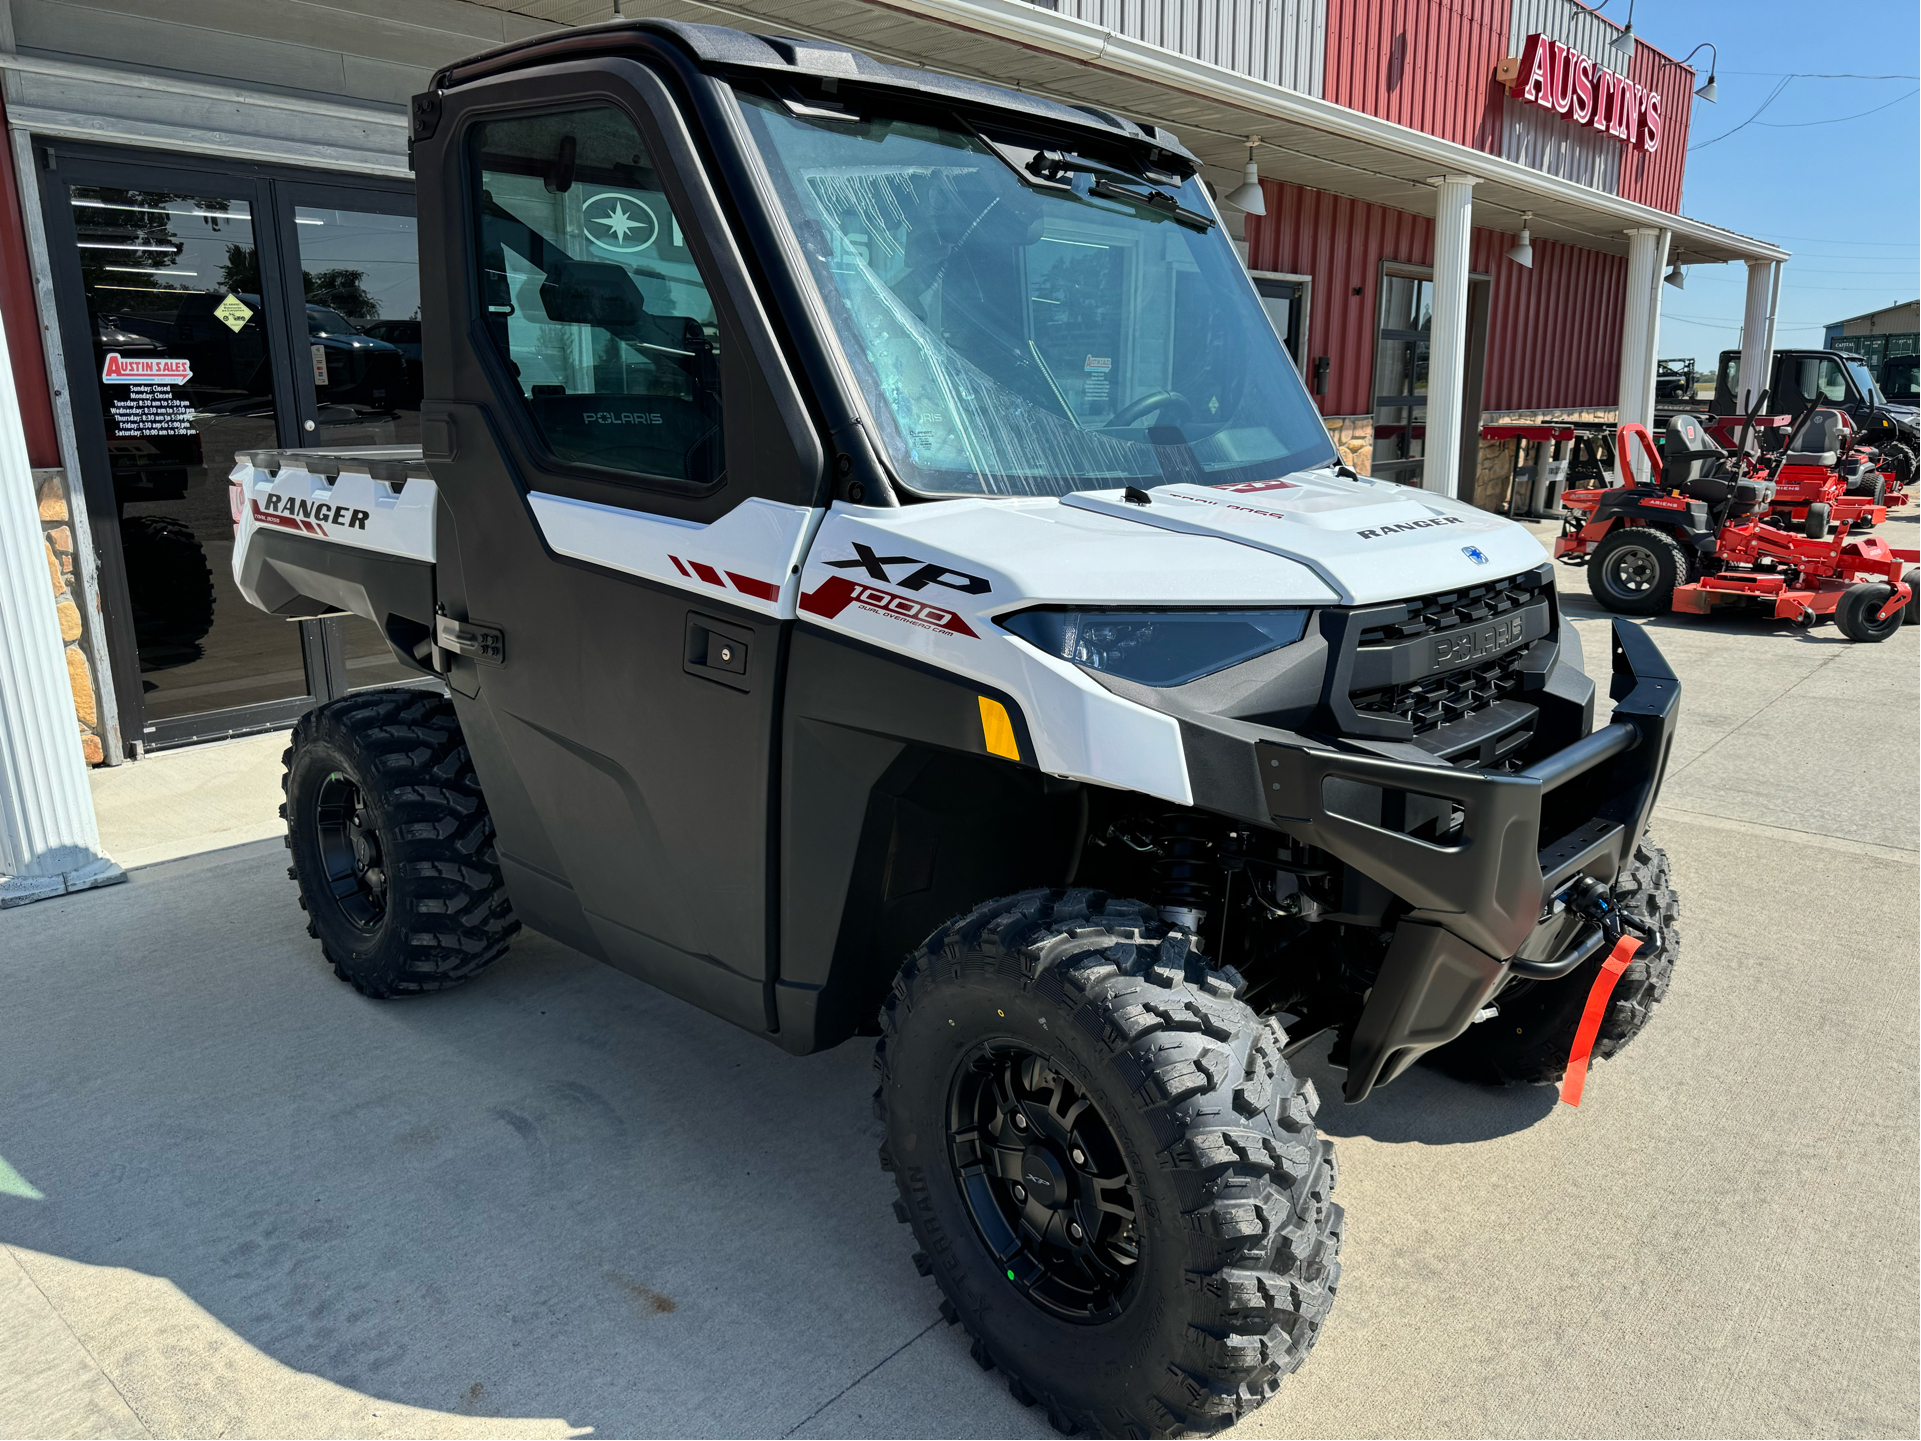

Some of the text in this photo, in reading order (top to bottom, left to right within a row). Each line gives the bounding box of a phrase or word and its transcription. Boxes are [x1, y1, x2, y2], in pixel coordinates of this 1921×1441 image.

[1523, 32, 1661, 152] AUSTIN'S
[106, 356, 187, 377] AUSTIN SALES
[583, 412, 662, 424] POLARIS
[264, 492, 370, 530] RANGER
[1356, 516, 1464, 539] RANGER
[820, 541, 992, 595] XP
[850, 585, 952, 625] 1000
[858, 604, 954, 637] DUAL OVERHEAD CAM
[1433, 616, 1523, 668] POLARIS
[1026, 1173, 1050, 1186] XP
[907, 1166, 994, 1323] X-TERRAIN
